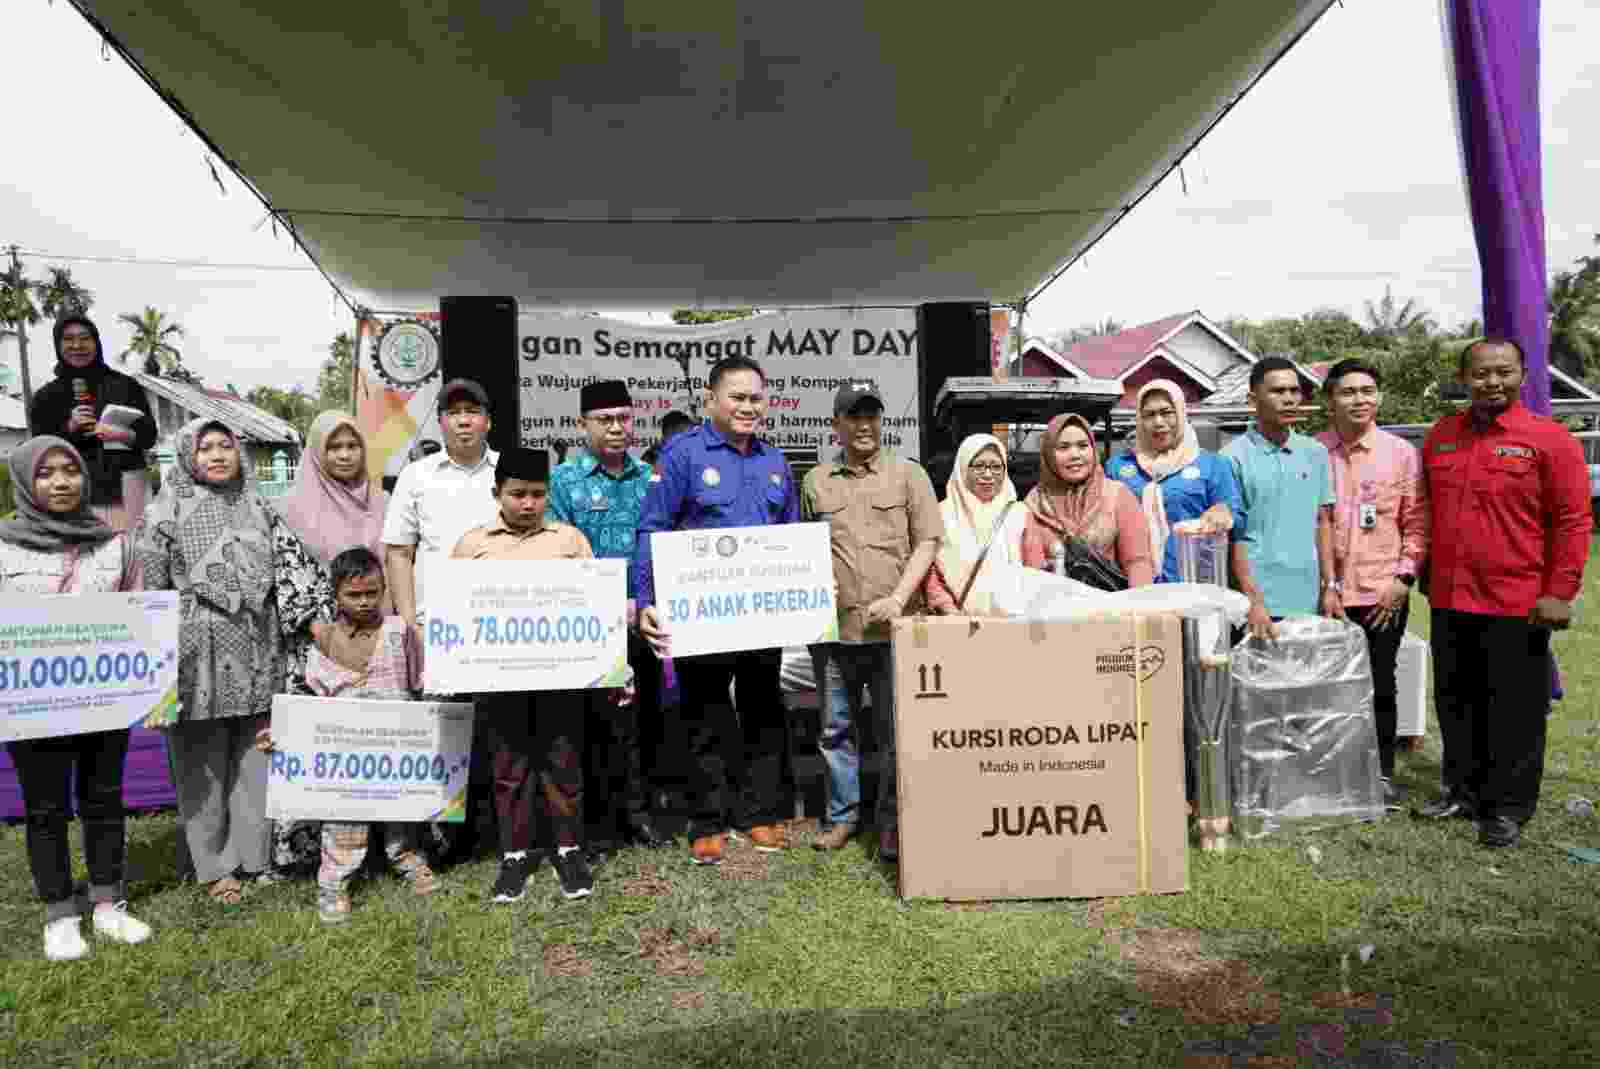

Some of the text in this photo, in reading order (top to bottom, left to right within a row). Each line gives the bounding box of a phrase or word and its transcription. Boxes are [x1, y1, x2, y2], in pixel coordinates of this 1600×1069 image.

[521, 328, 919, 363] gan Semangat MAY DAY
[520, 416, 554, 431] gun
[780, 414, 833, 428] harmo
[667, 586, 831, 620] 30 ANAK PEKERJA
[428, 616, 465, 653] Rp.
[932, 721, 1149, 749] KURSI RODA LIPAT
[271, 751, 306, 781] Rp.
[979, 758, 1105, 774] Made in Indonesia
[982, 804, 1108, 837] JUARA
